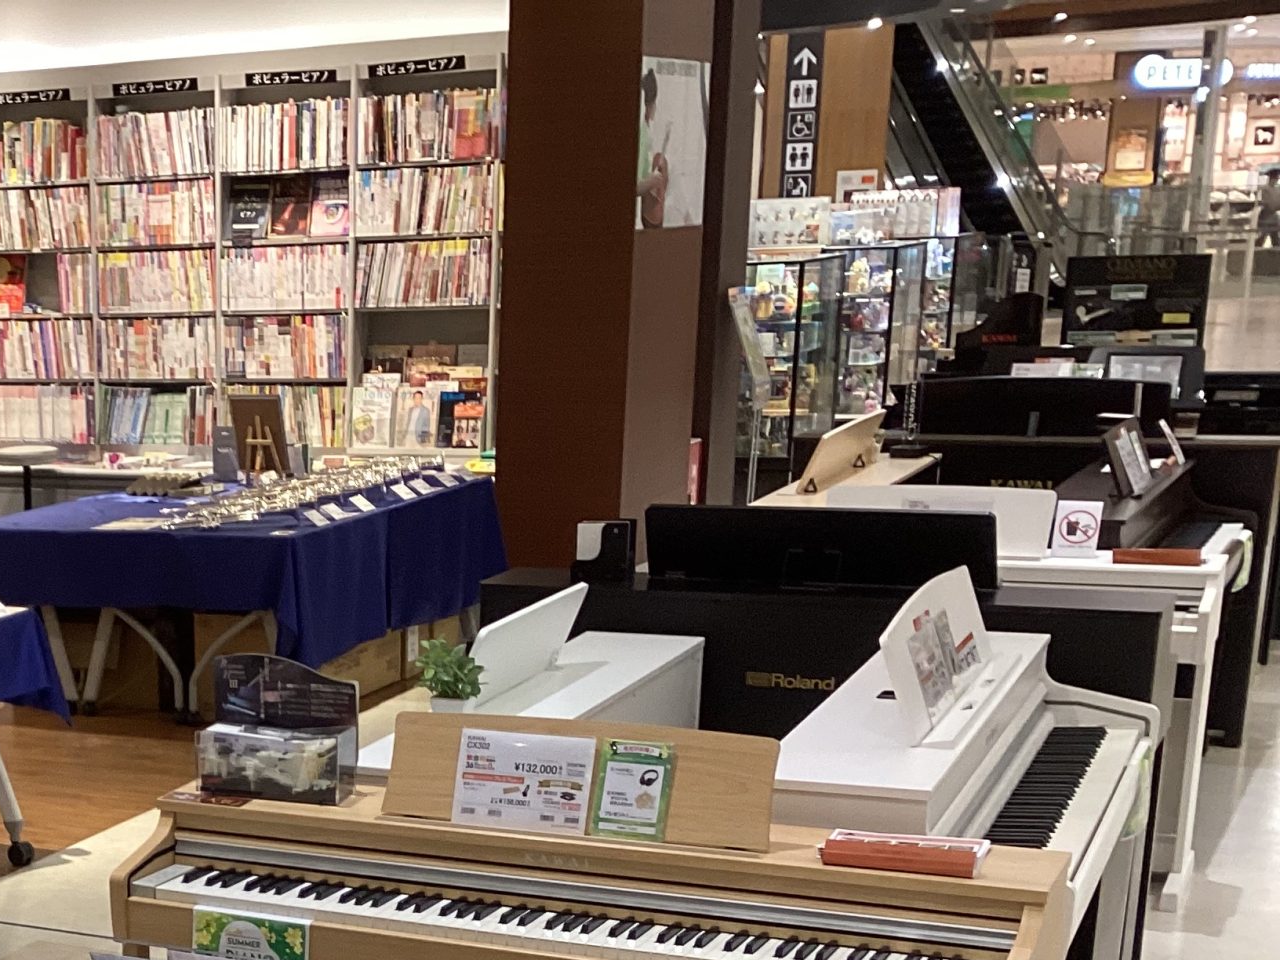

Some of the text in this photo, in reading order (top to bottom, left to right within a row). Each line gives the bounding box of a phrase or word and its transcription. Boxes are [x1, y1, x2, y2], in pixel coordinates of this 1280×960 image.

[376, 57, 457, 76] ポピュラーピアノ
[253, 70, 329, 85] ポピュラーピアノ
[120, 79, 192, 95] ポピュラーピアノ
[771, 673, 835, 690] Roland
[514, 762, 558, 775] ¥132,000
[227, 937, 261, 948] SUMMER
